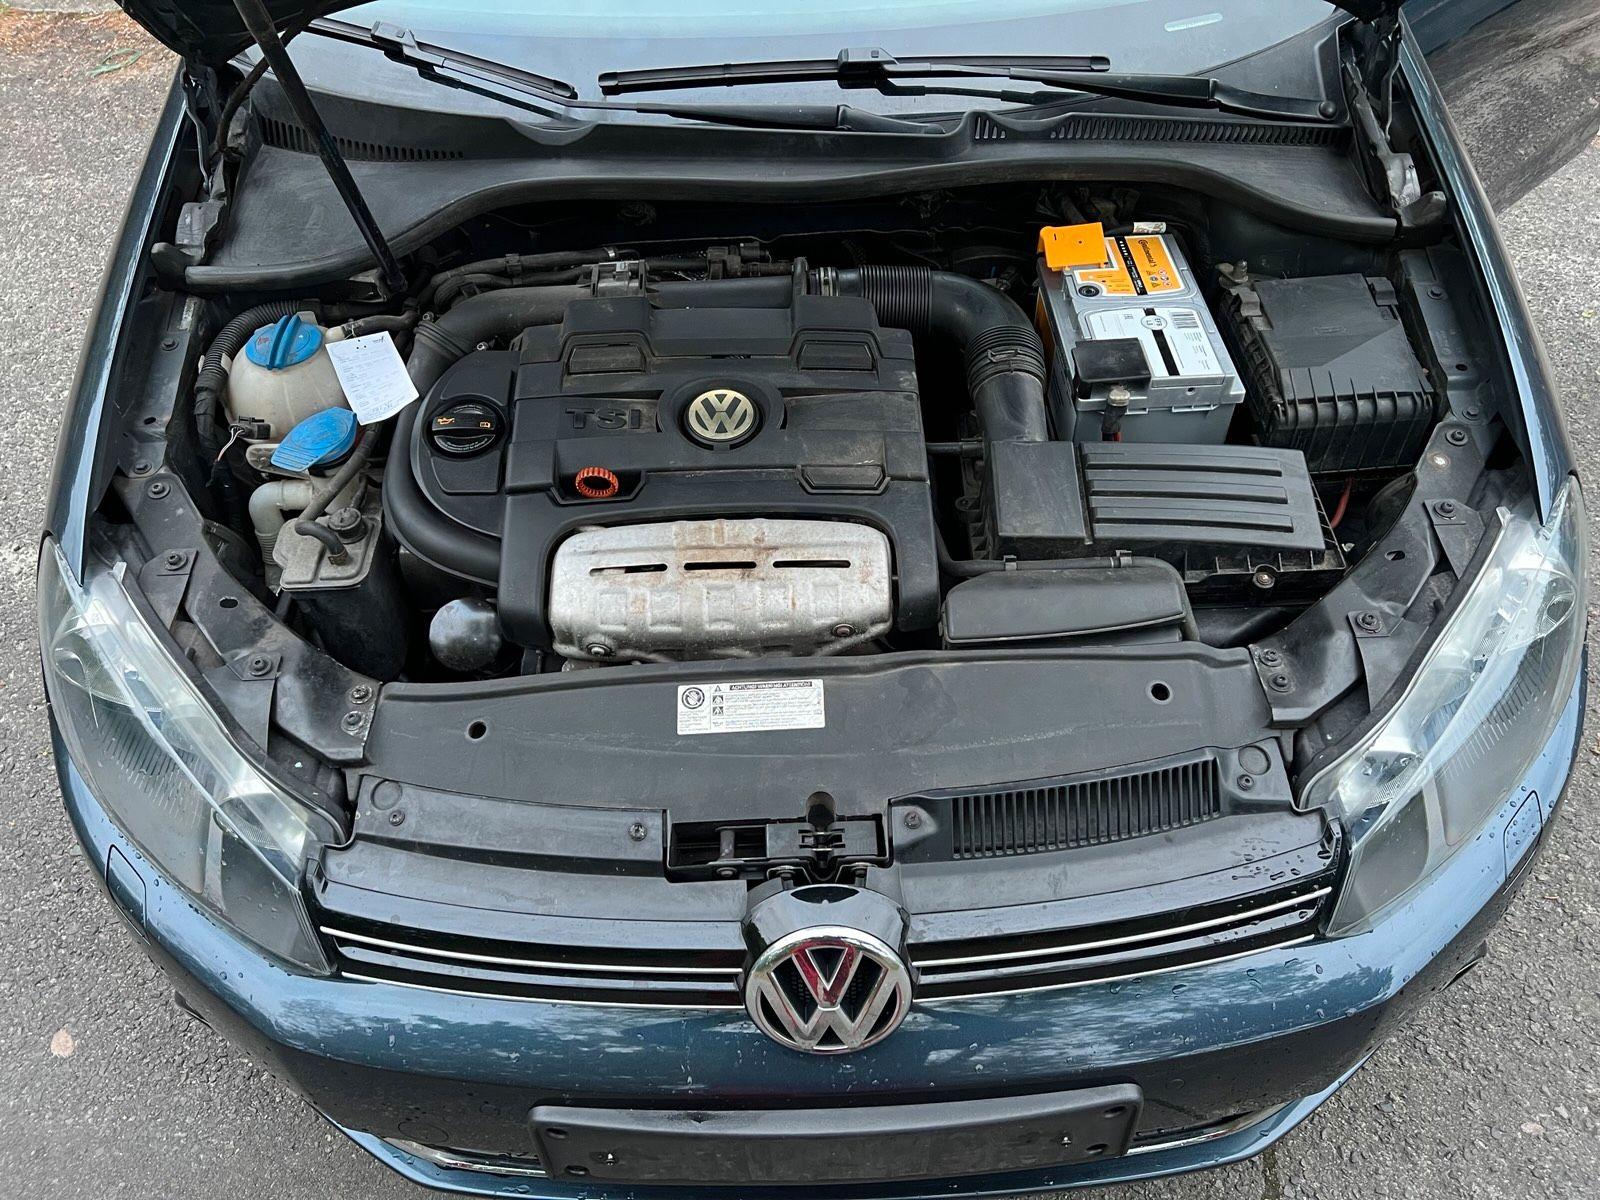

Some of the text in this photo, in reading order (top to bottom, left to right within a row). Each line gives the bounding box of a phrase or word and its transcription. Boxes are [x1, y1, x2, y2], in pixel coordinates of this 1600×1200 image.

[565, 407, 641, 430] TSI
[688, 389, 755, 440] VW
[745, 925, 913, 1055] VW
